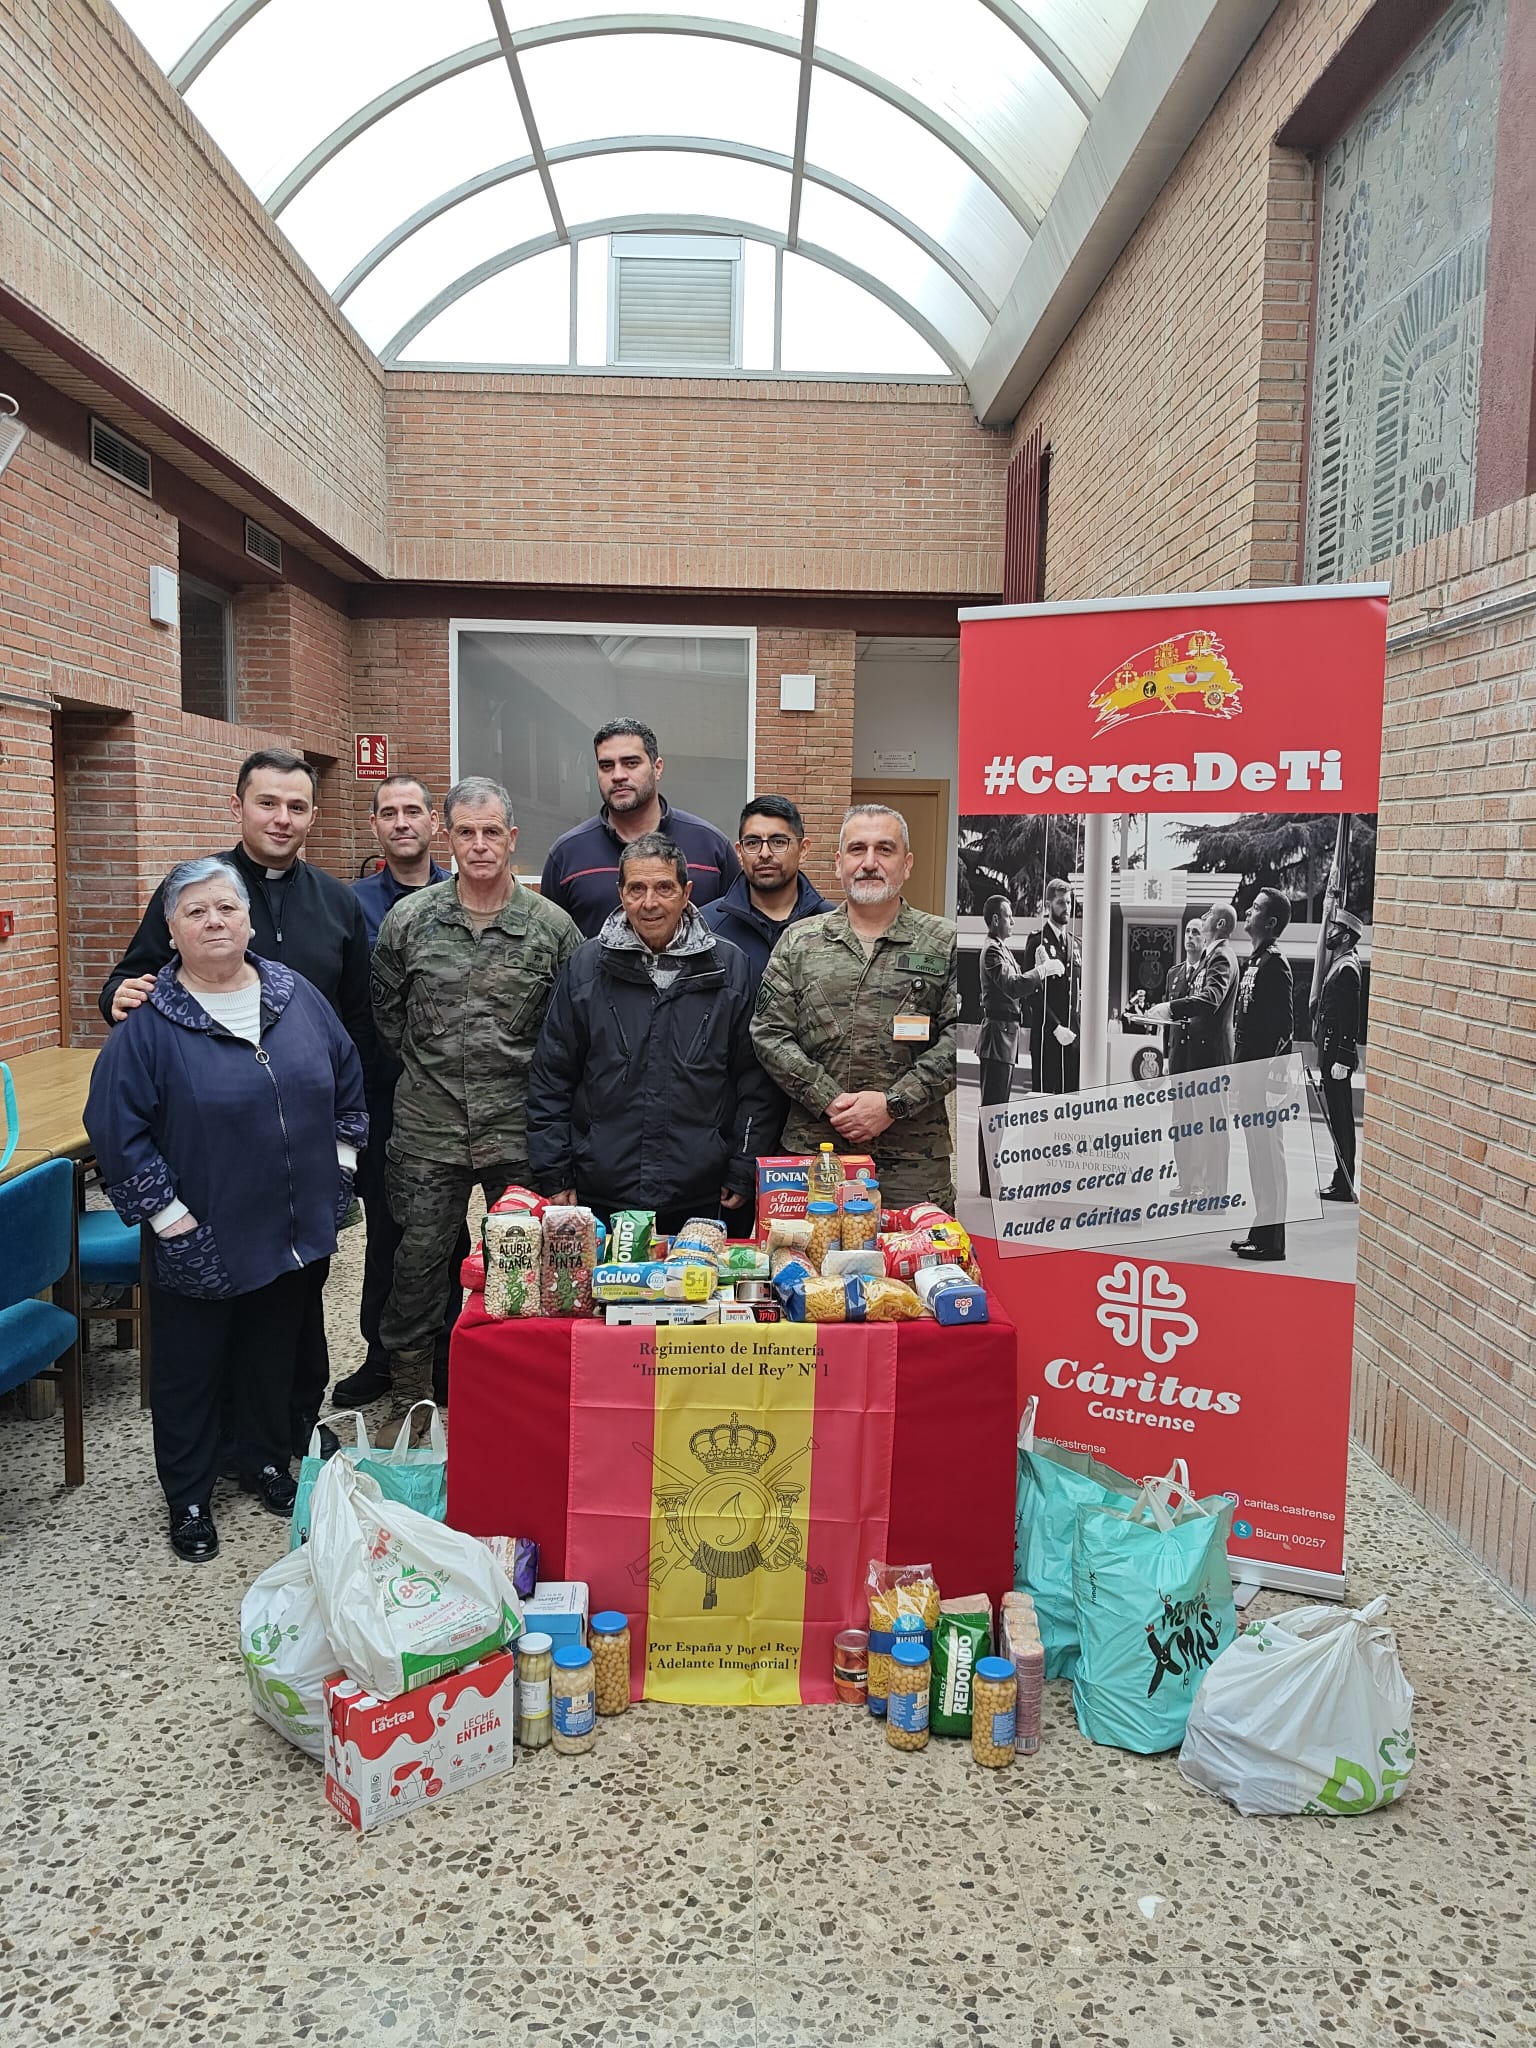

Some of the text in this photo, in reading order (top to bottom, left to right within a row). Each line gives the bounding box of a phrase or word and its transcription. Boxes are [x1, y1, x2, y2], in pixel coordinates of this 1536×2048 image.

[984, 750, 1342, 795] #CercaDeTi
[988, 1075, 1231, 1134] ¿Tienes alguna necesidad?
[992, 1103, 1301, 1169] ¿Conoces a alguien que la tenga?
[766, 1170, 809, 1183] FONTAN
[1058, 1160, 1080, 1171] VIDA
[1082, 1162, 1100, 1173] POR
[999, 1160, 1178, 1202] Estamos cerca de ti.
[767, 1203, 805, 1214] María
[1002, 1192, 1247, 1238] Acude a Cáritas Castrense.
[499, 1242, 532, 1258] ALUBIA
[549, 1242, 583, 1257] ALUBIA
[618, 1221, 635, 1263] ONDO
[498, 1256, 532, 1273] BLANCA
[549, 1255, 583, 1269] PINTA
[596, 1270, 640, 1284] Calvo
[685, 1271, 708, 1287] 5+1
[956, 1299, 971, 1307] SOS
[639, 1342, 824, 1359] Regimiento de Infantería
[731, 1362, 753, 1376] del
[823, 1364, 829, 1377] 1
[1044, 1358, 1241, 1415] Cáritas
[1088, 1401, 1196, 1433] Castrense
[1243, 1497, 1336, 1521] caritas.castrense
[1255, 1527, 1326, 1549] Bizum 00257
[649, 1641, 800, 1656] Por España y por el Rey
[1147, 1611, 1219, 1698] XMAS
[657, 1658, 714, 1670] Adelante
[718, 1658, 789, 1672] Inmemorial
[953, 1635, 972, 1714] REDONDO
[938, 1677, 946, 1711] ARROZ
[464, 1709, 495, 1730] LECHE
[456, 1717, 501, 1745] ENTERA
